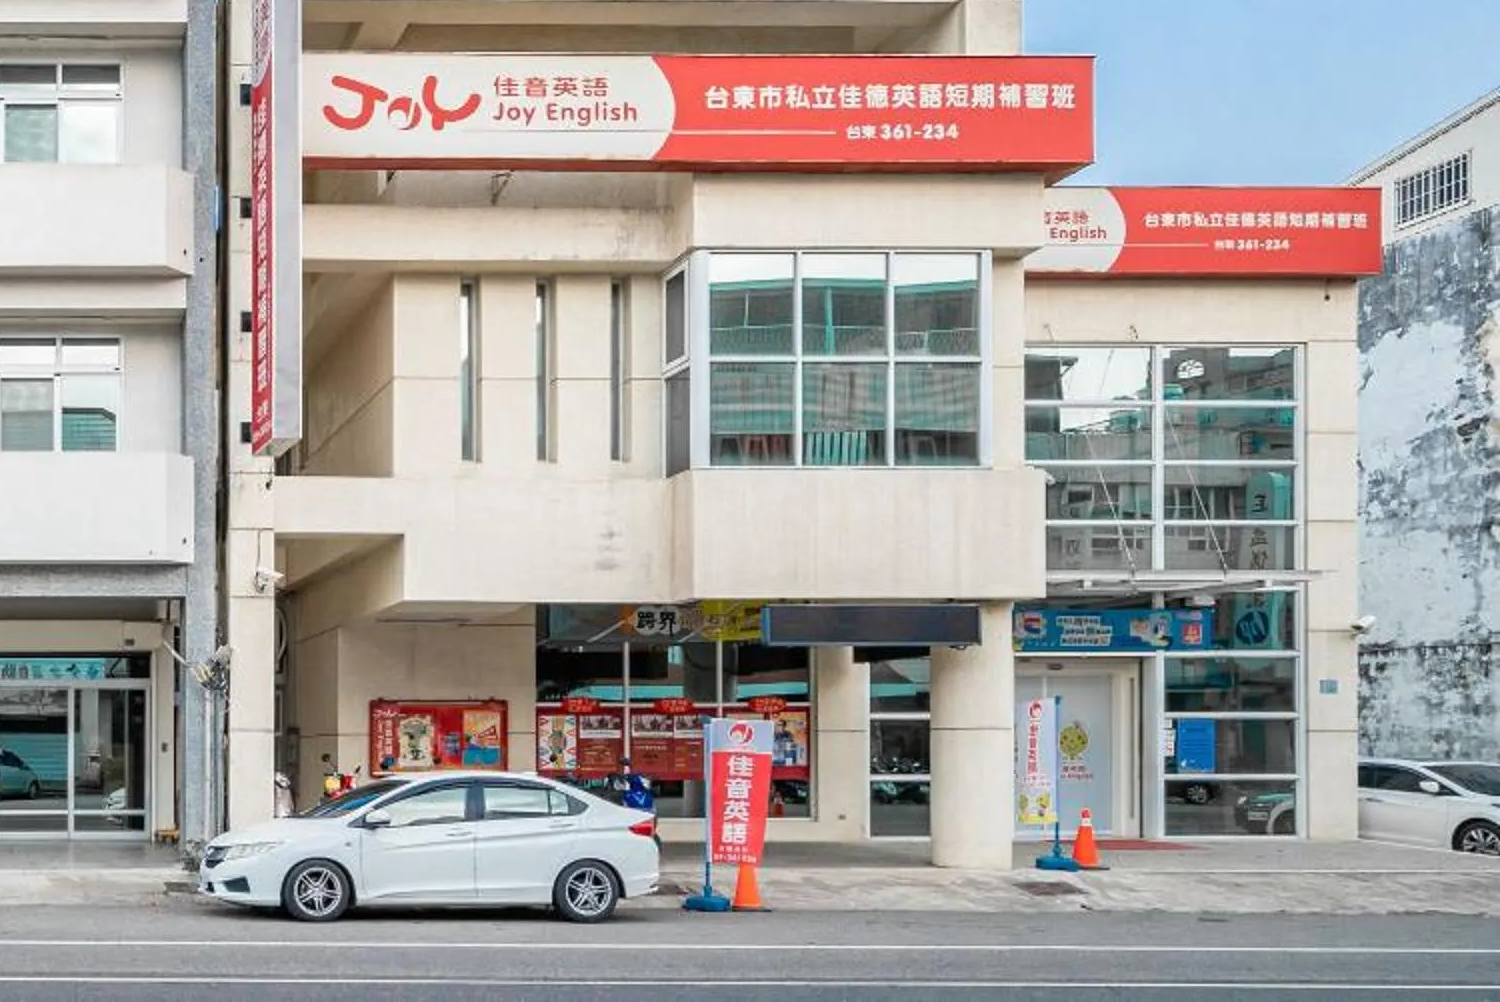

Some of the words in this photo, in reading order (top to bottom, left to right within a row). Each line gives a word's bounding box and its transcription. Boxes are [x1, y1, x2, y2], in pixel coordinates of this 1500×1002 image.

[493, 76, 610, 97] 佳音英語
[704, 83, 1076, 109] 台東市私立佳德英語短期補習班
[493, 102, 537, 125] Joy
[545, 101, 638, 126] English
[846, 125, 877, 140] 台東
[880, 124, 959, 140] 361-234
[1050, 227, 1107, 243] English
[1236, 239, 1290, 252] 361-234
[721, 755, 755, 845] 佳音英語
